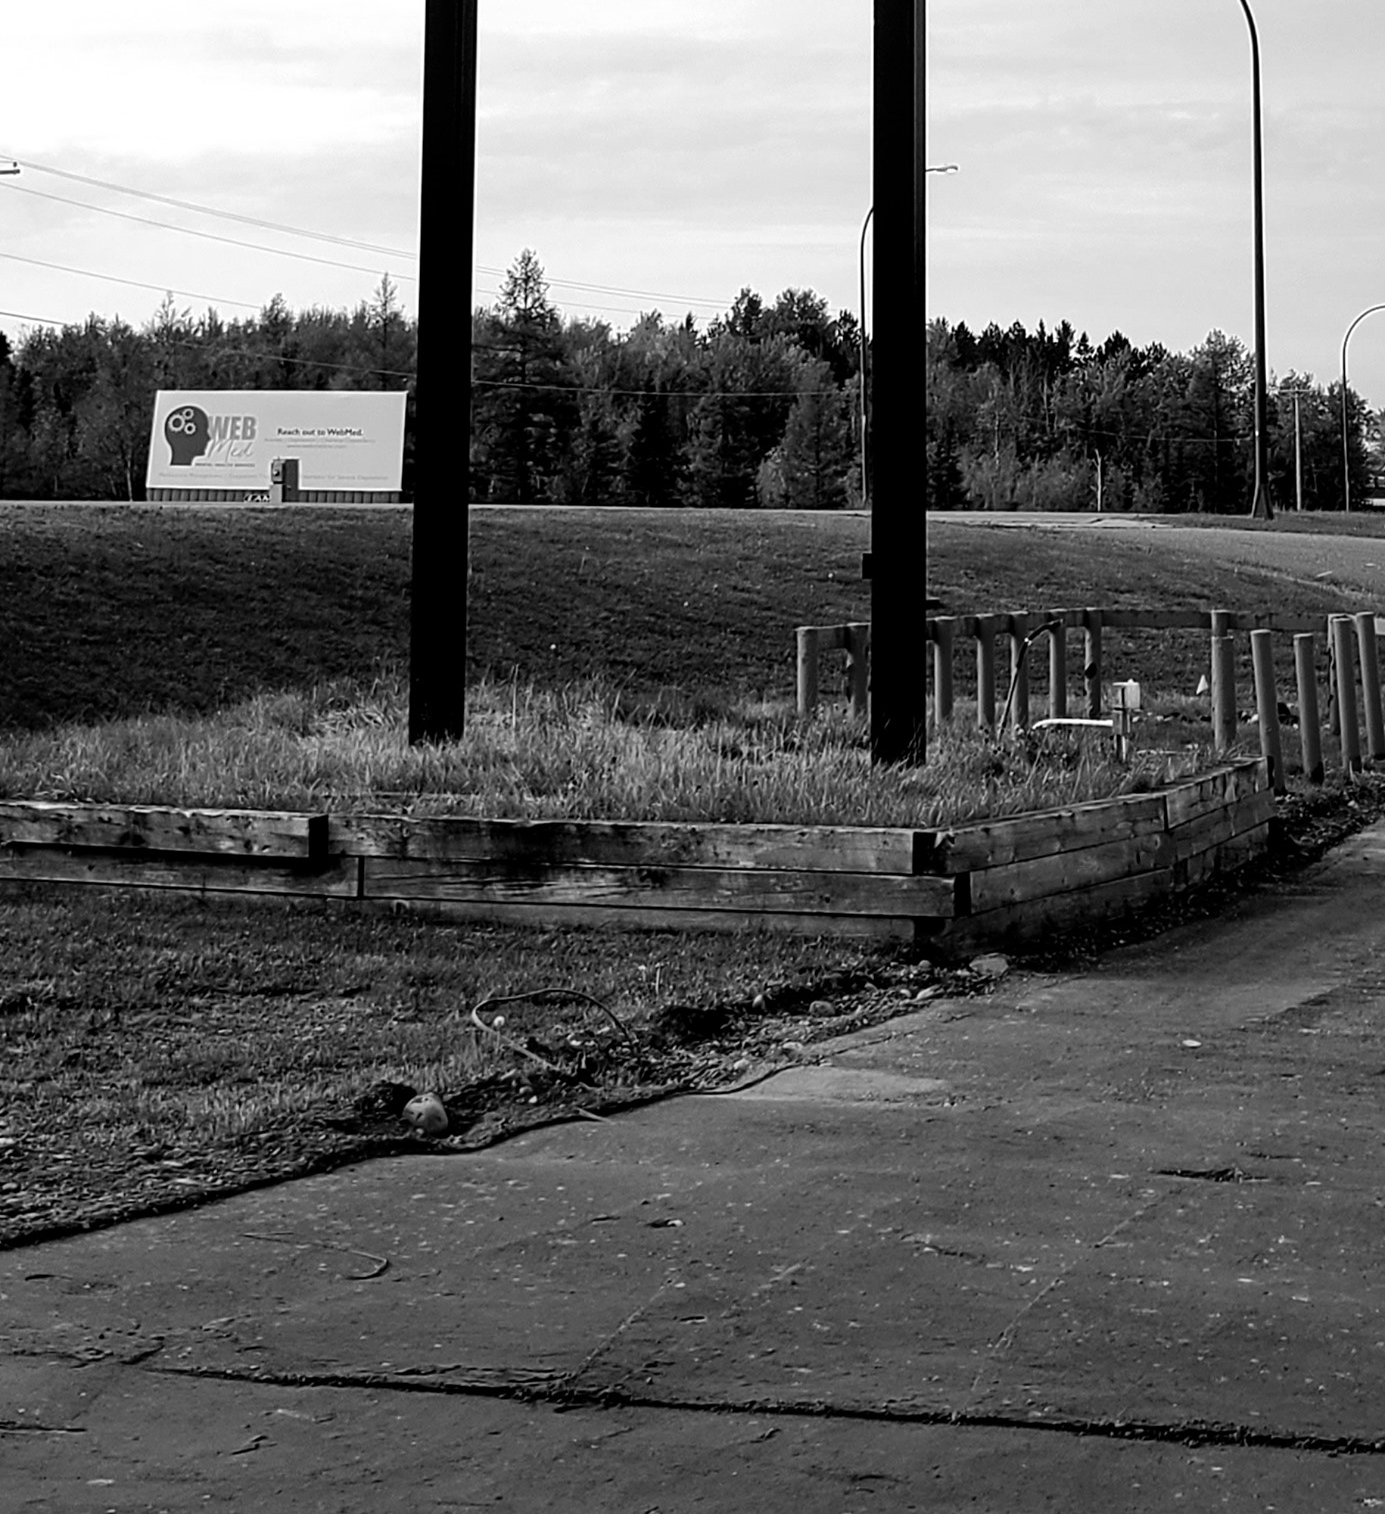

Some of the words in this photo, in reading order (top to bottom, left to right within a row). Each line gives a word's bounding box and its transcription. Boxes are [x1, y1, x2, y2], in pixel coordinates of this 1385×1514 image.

[207, 416, 257, 440] WEB
[277, 427, 300, 436] Reach
[317, 428, 326, 436] to
[206, 438, 254, 463] Med
